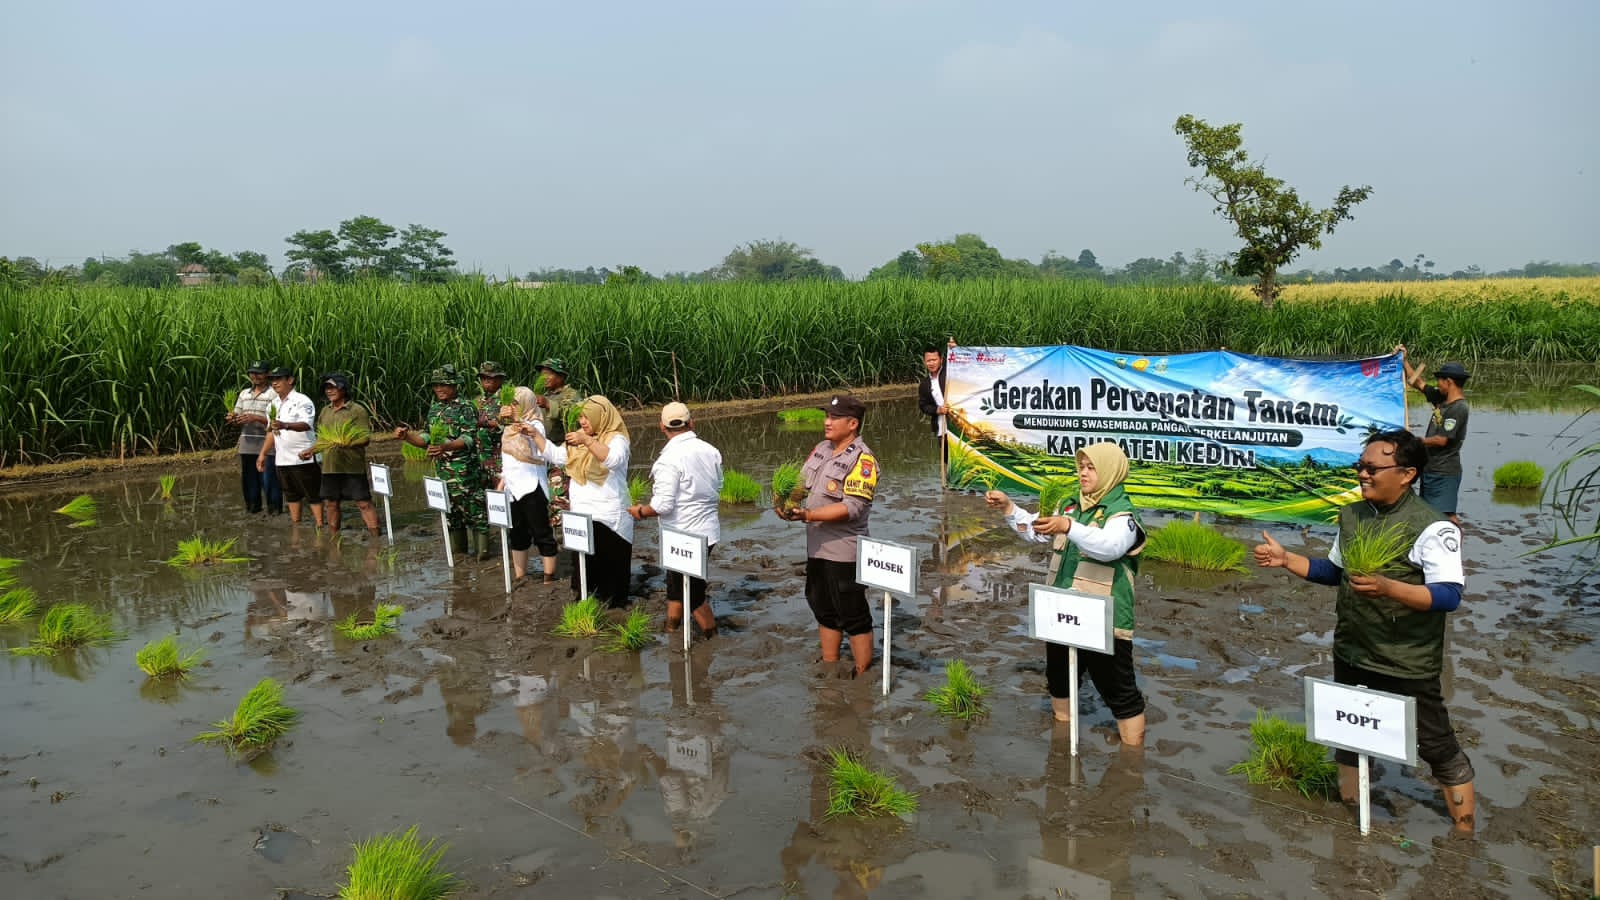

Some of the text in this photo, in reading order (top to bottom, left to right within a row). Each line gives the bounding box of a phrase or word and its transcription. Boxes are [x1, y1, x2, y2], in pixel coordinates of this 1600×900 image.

[993, 378, 1339, 426] Gerakan Percepatan Tanam
[1023, 417, 1079, 428] MENDUKUNG
[1082, 419, 1149, 431] SWASEMBADA
[1047, 434, 1256, 468] KABATEN KEDIRI
[867, 557, 904, 574] POLSEK
[1057, 612, 1081, 626] PPL
[1335, 709, 1381, 730] POPT
